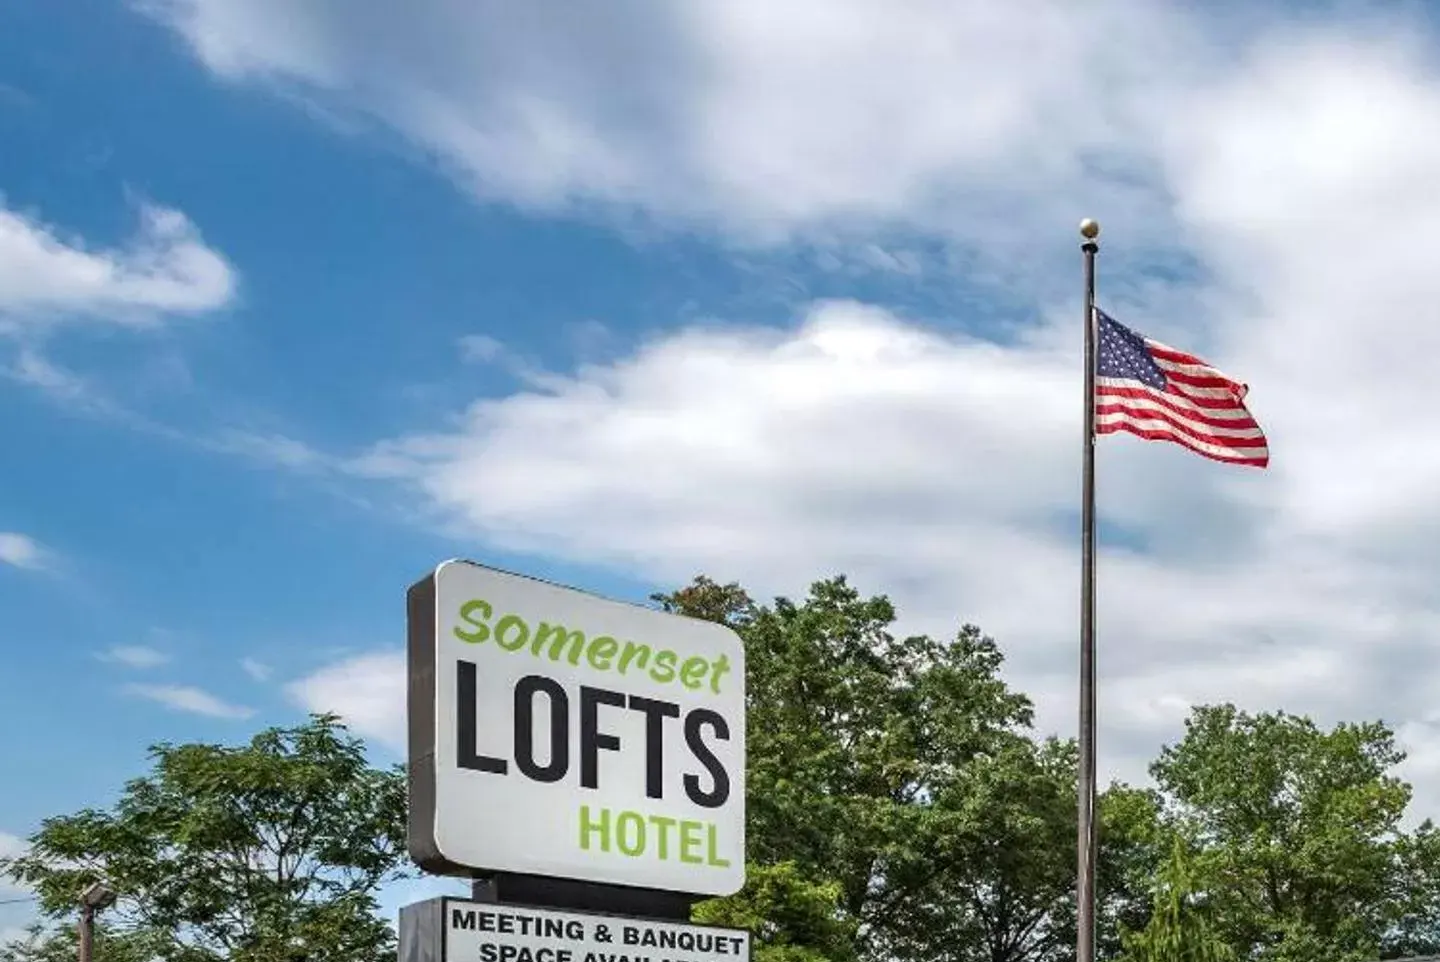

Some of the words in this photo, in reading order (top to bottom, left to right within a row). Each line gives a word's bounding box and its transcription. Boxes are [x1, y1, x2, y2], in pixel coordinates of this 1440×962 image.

[453, 599, 731, 695] Somerset
[456, 659, 731, 809] LOFTS
[578, 805, 732, 869] HOTEL
[452, 909, 585, 943] MEETING
[594, 924, 613, 944] &
[623, 926, 745, 955] BANQUET
